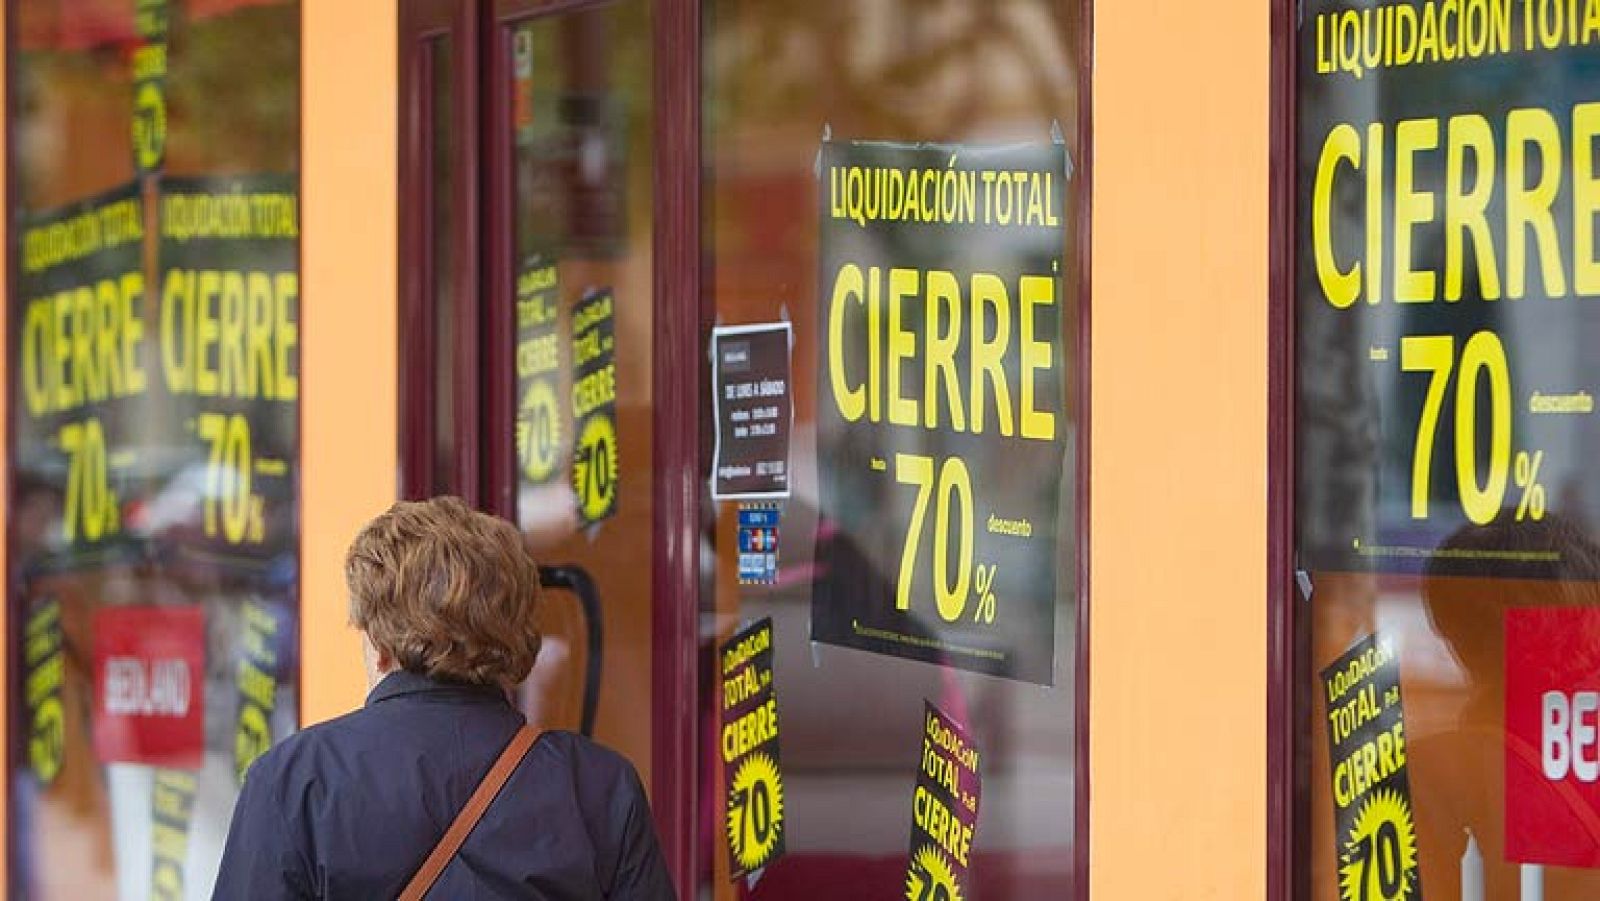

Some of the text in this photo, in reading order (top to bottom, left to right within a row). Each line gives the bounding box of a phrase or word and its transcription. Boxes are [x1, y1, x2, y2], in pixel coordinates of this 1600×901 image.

[830, 153, 1058, 227] LIQUIDACIÓN TOTAL
[1312, 102, 1600, 310] CIERRE
[22, 270, 146, 417] CIERRE
[161, 267, 298, 401] CIERRE
[828, 263, 1055, 440] CIERRE
[574, 437, 609, 506] 70
[724, 664, 760, 710] TOTAL
[1329, 683, 1382, 745] TOTAL
[722, 699, 778, 764] CIERRE
[923, 738, 960, 799] TOTAL
[1333, 721, 1407, 809] CIERRE
[729, 778, 772, 851] 70
[912, 785, 974, 868] CIERRE
[1348, 820, 1401, 901] 70
